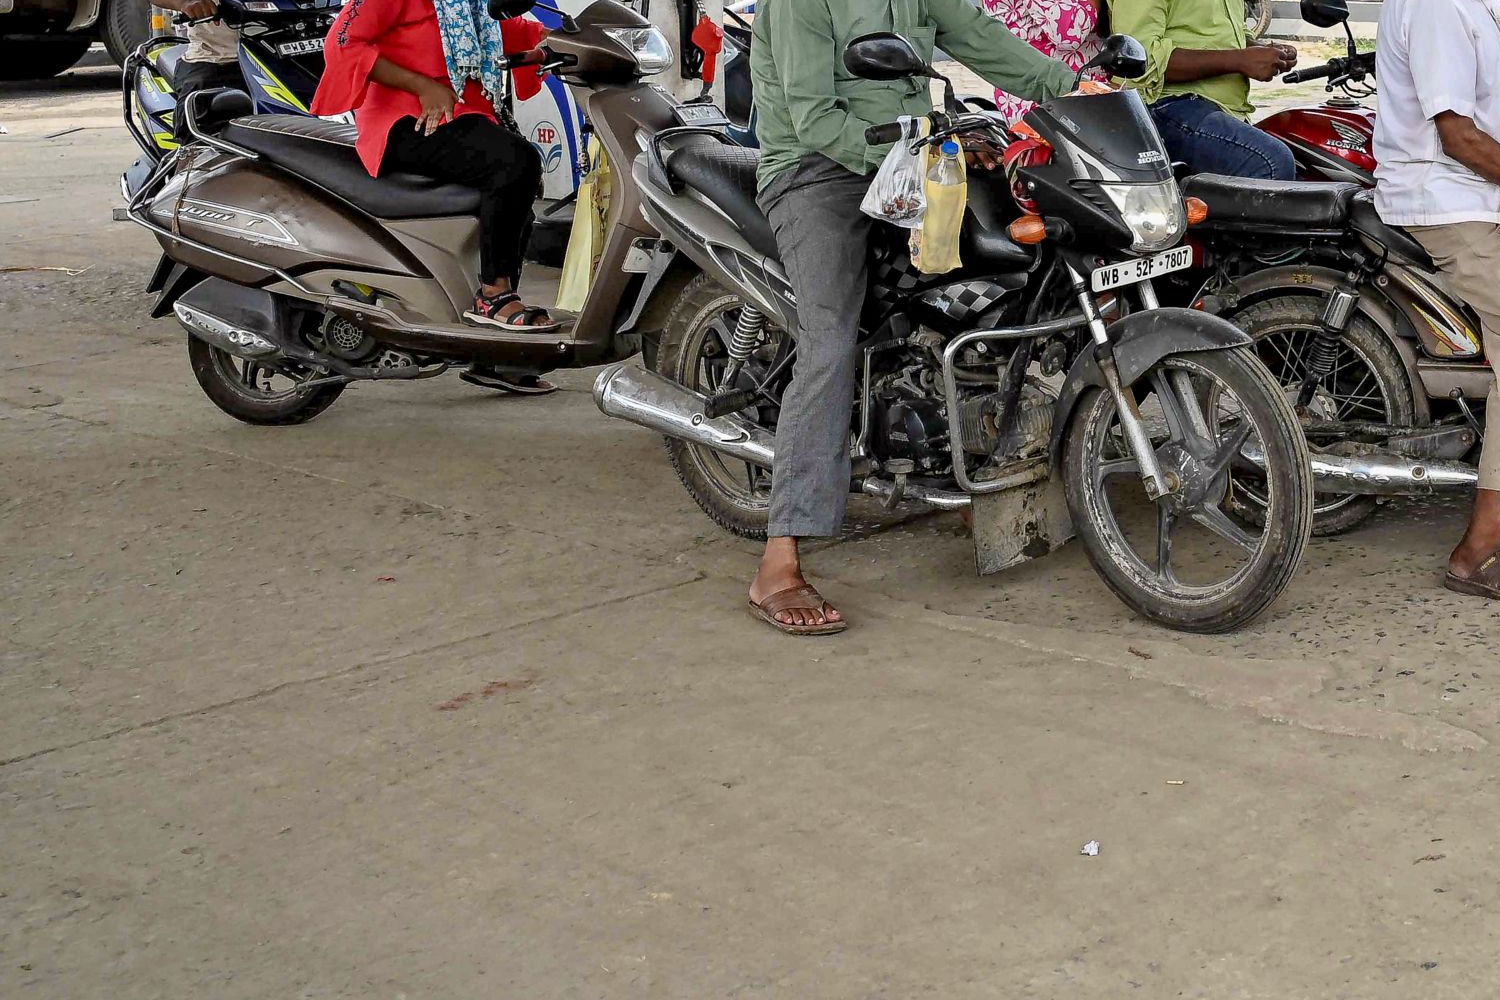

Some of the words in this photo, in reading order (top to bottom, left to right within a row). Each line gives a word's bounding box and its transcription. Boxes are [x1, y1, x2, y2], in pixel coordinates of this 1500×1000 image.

[537, 127, 555, 144] HP
[1326, 139, 1367, 154] HONDA
[1101, 268, 1119, 287] WB
[1136, 260, 1154, 278] 52F
[1165, 250, 1189, 271] 7807
